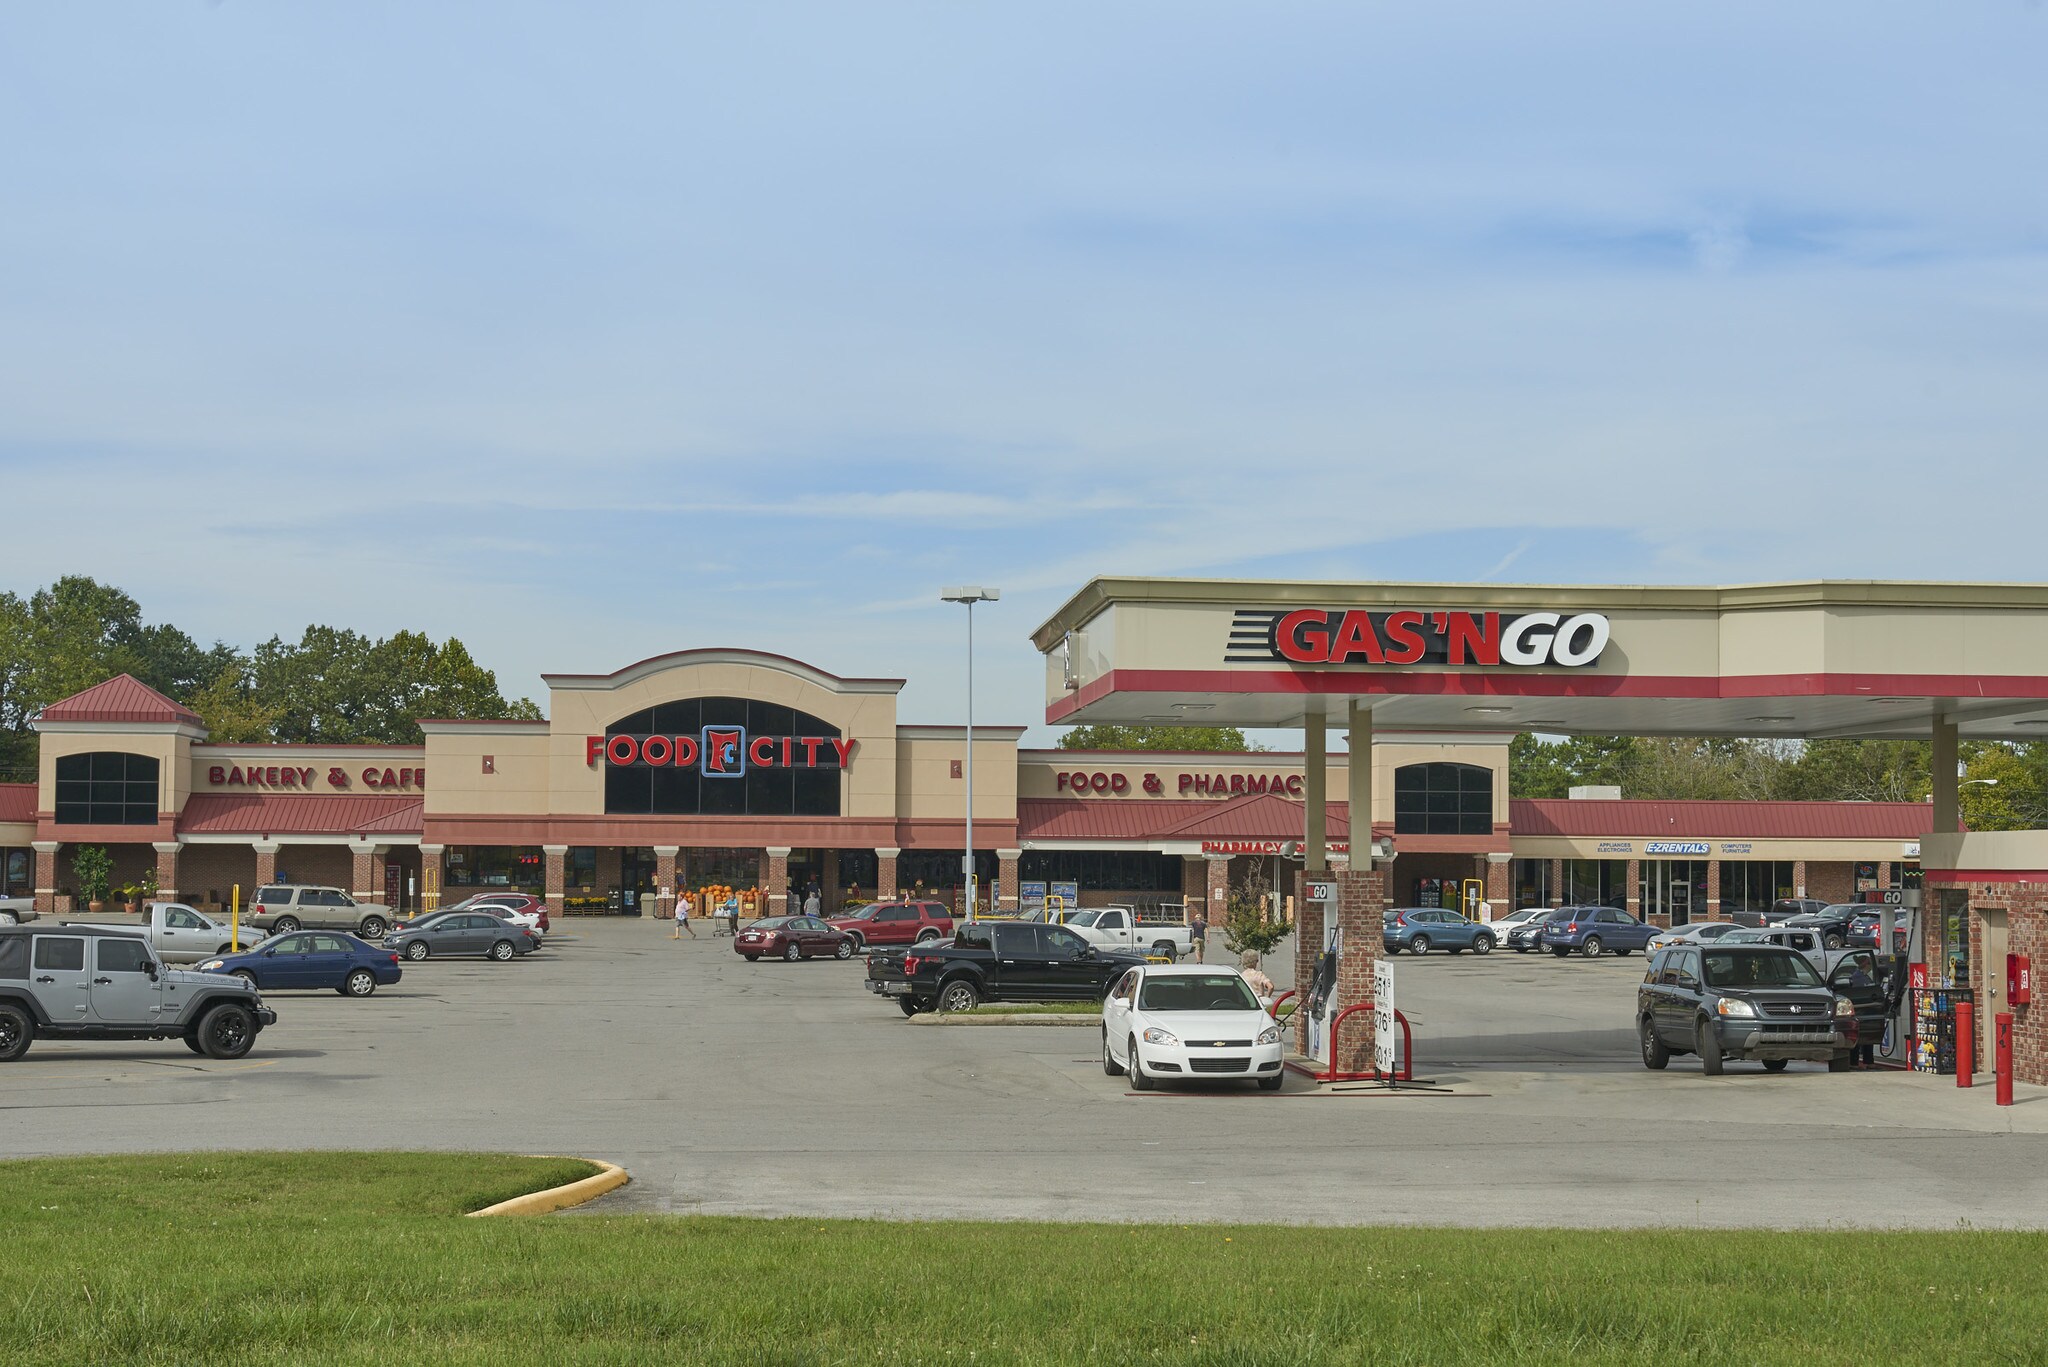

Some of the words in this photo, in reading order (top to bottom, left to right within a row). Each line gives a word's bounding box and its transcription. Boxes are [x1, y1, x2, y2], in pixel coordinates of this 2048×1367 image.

[586, 734, 699, 767] FOOD
[749, 736, 857, 768] CITY
[208, 765, 315, 786] BAKERY
[327, 767, 347, 787] &
[361, 767, 425, 788] CAFE
[1057, 771, 1128, 792] FOOD
[1142, 773, 1162, 793] &
[1201, 841, 1283, 854] PHARMACY
[1313, 885, 1327, 898] GO
[1884, 891, 1901, 904] GO
